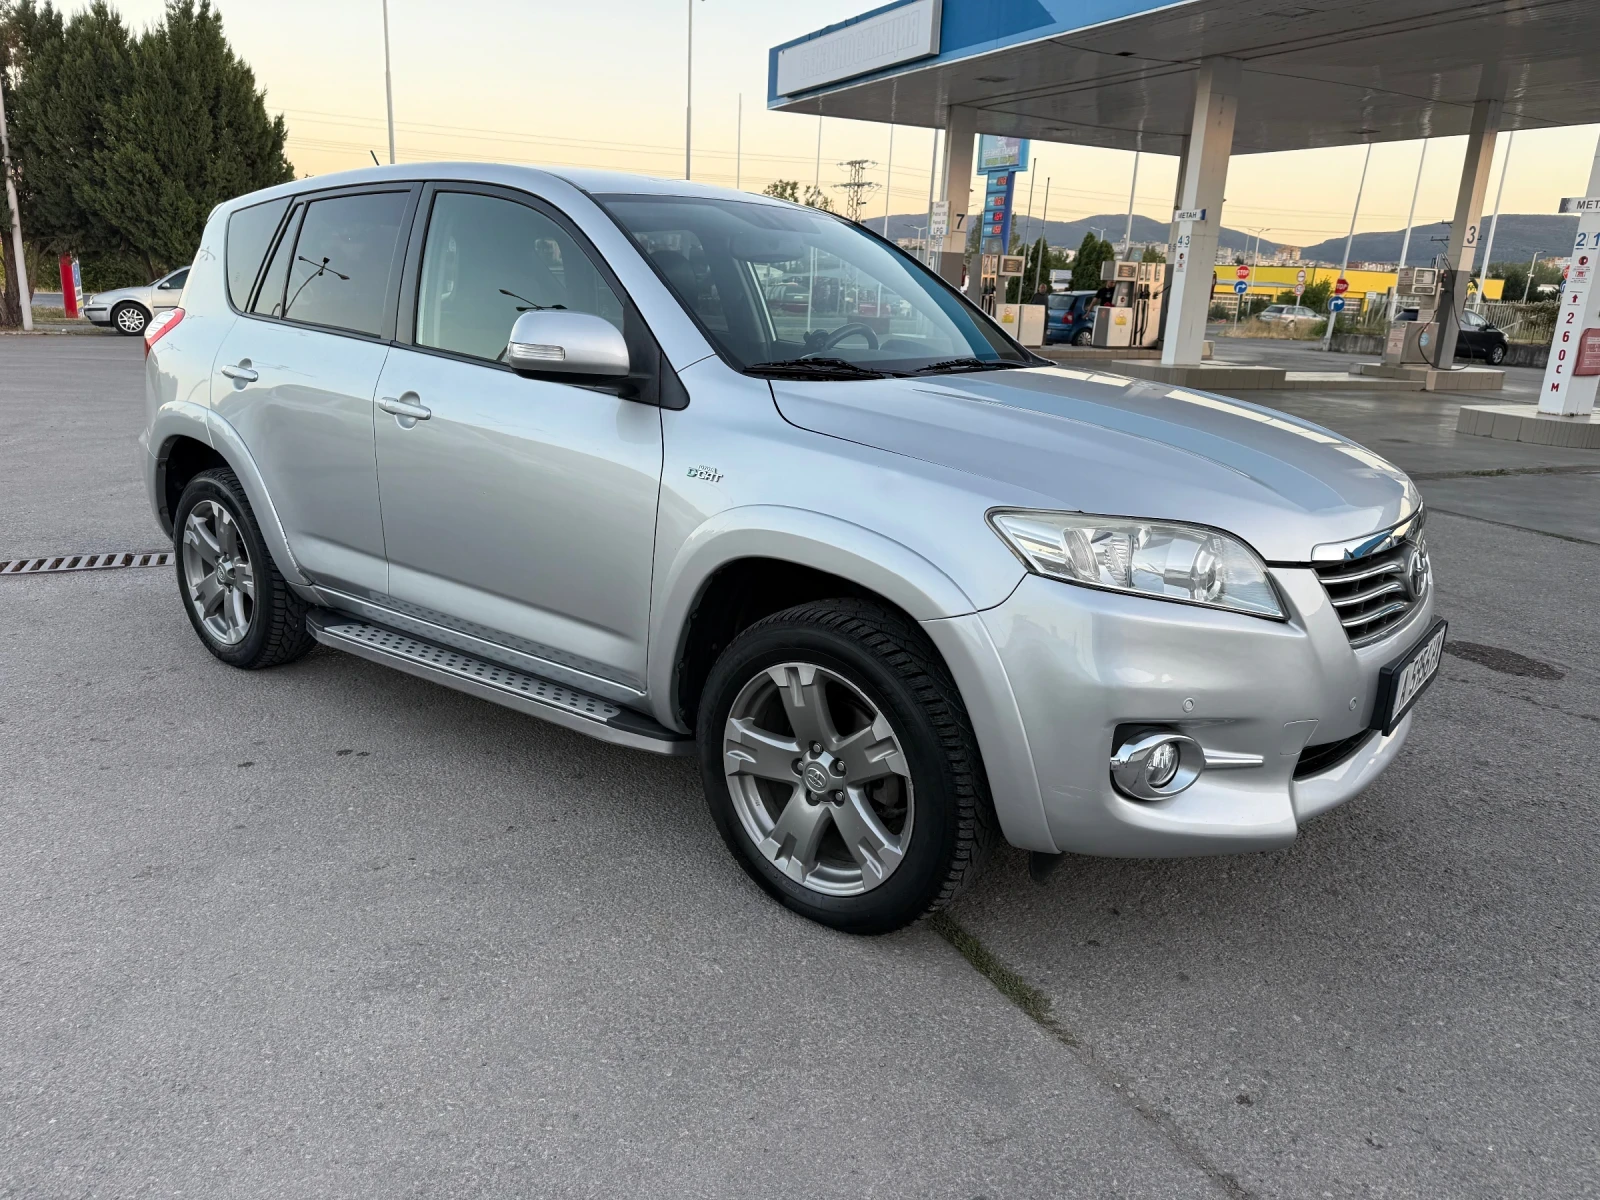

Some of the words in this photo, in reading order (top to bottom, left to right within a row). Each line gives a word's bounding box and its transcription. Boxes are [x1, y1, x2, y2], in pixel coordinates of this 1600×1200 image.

[1576, 200, 1600, 210] МЕТ
[956, 213, 965, 230] 7
[933, 226, 944, 235] LPG
[1466, 225, 1477, 244] 3
[1178, 235, 1183, 246] 4
[1184, 235, 1190, 246] 3
[1575, 232, 1587, 247] 2
